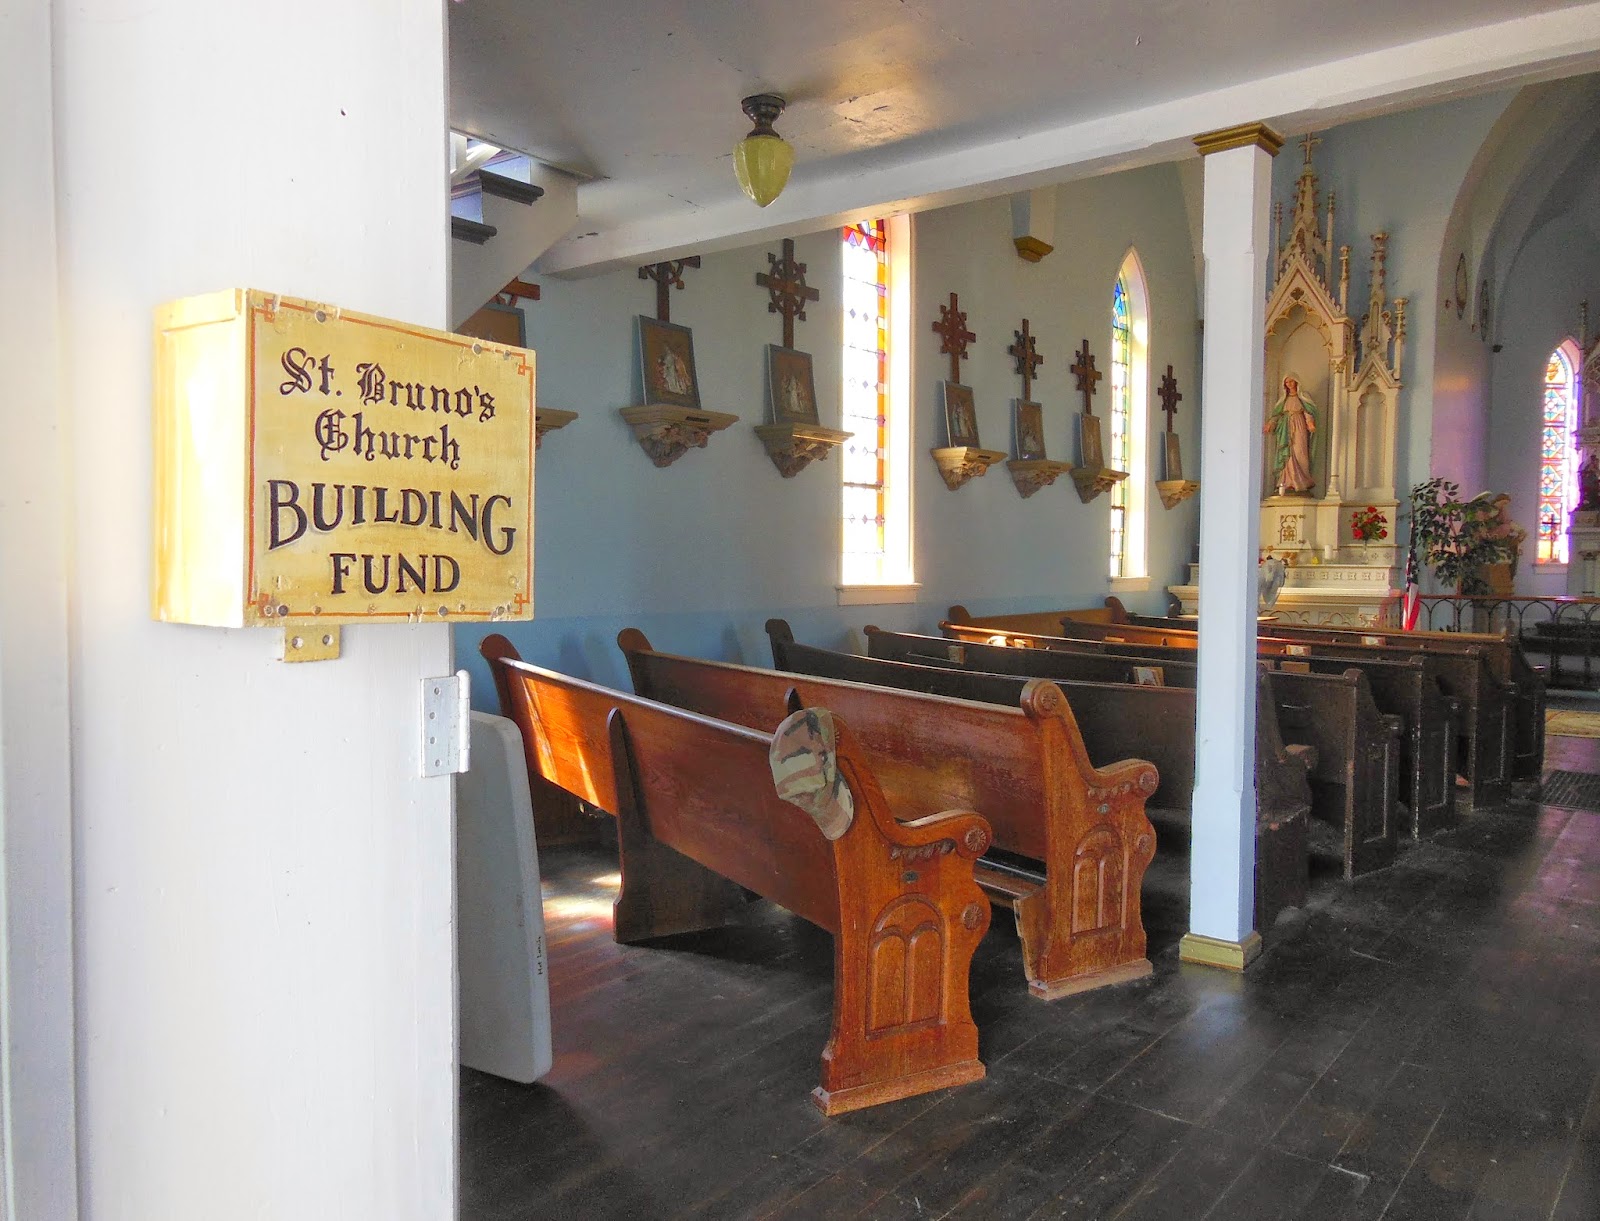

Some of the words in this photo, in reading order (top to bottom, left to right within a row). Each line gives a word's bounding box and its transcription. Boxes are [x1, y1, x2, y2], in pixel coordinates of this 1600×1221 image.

[279, 346, 342, 396] St.
[356, 362, 496, 423] Bruno's
[315, 408, 461, 470] Church
[267, 479, 517, 556] BUILDING
[330, 553, 461, 595] FUND
